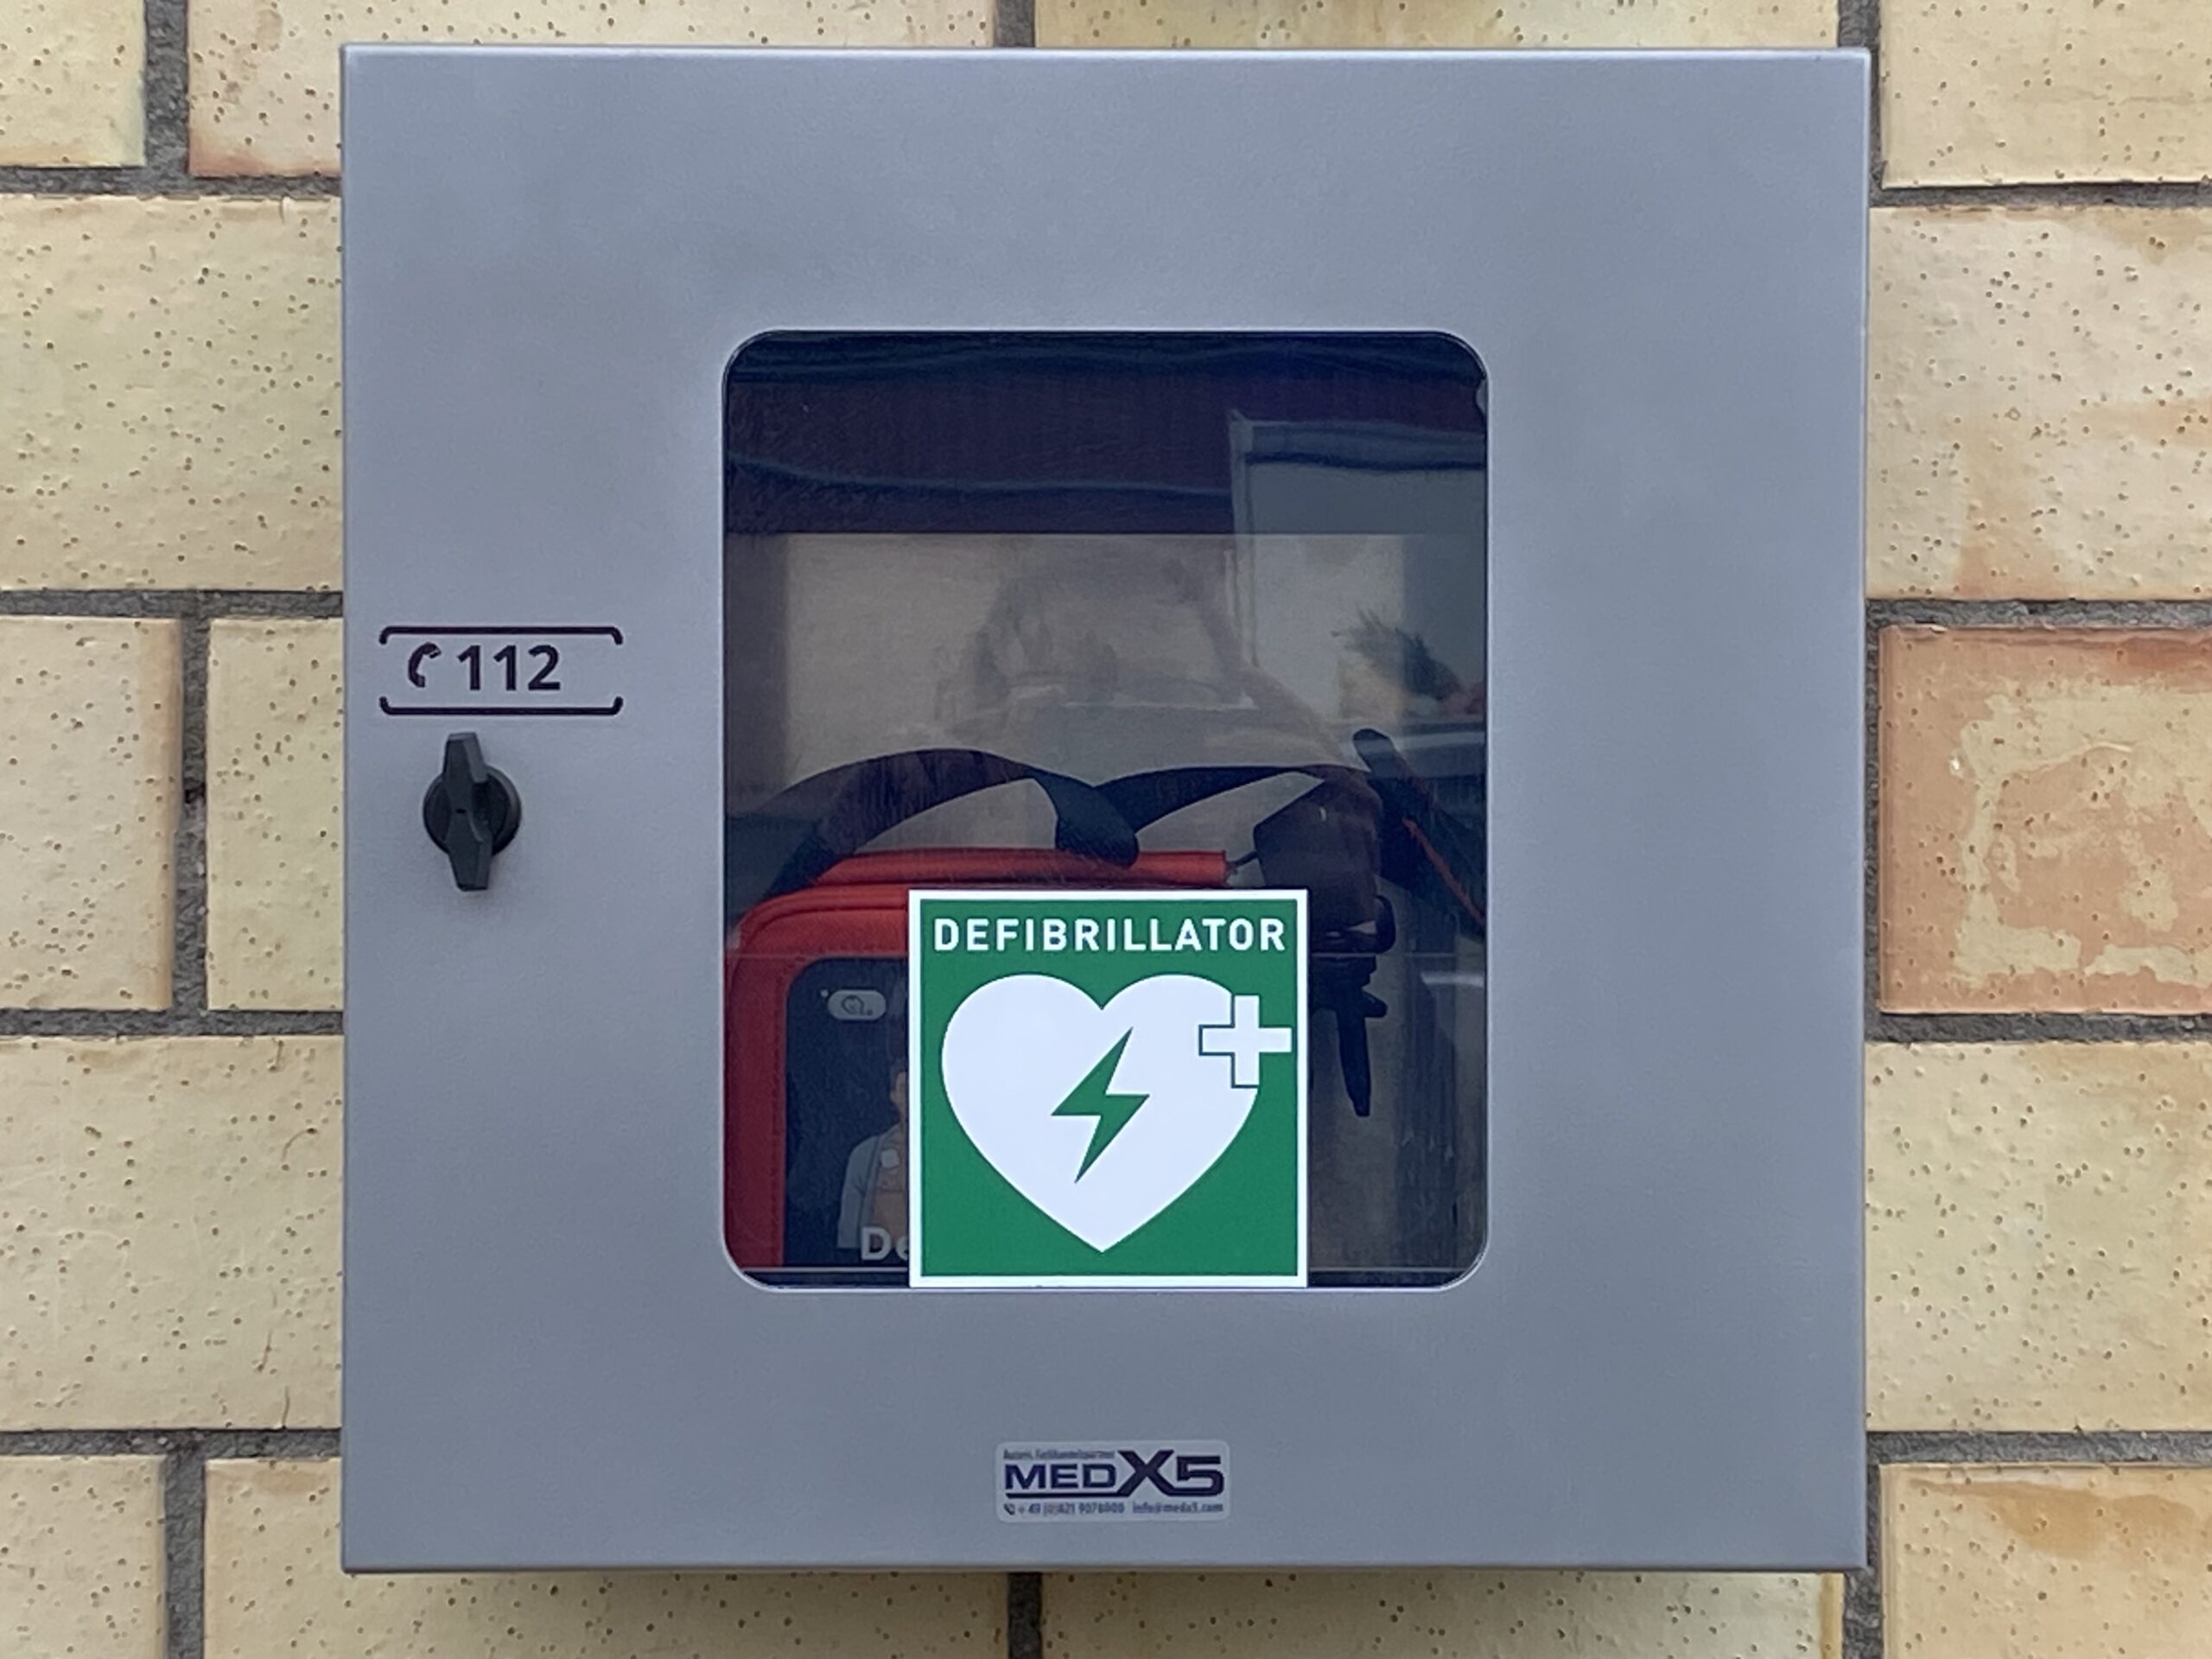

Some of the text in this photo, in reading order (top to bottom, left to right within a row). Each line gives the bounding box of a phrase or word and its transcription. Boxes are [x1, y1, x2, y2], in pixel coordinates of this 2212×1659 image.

[457, 645, 561, 691] 112
[933, 918, 1286, 951] DEFIBRILLATOR
[1005, 1450, 1224, 1497] MEDX5
